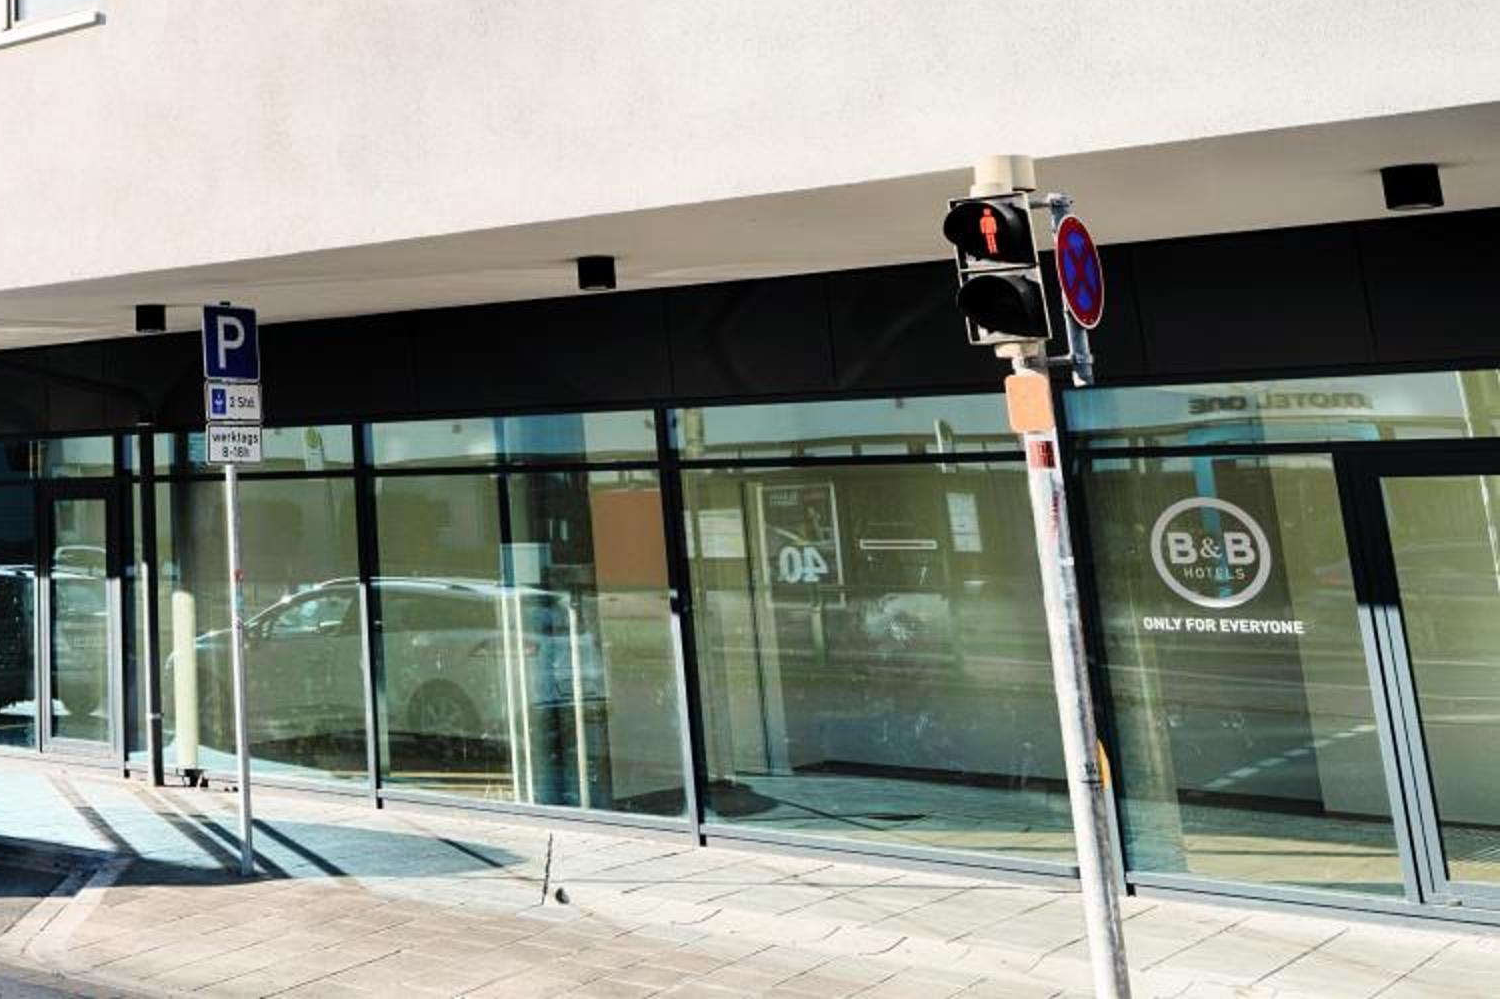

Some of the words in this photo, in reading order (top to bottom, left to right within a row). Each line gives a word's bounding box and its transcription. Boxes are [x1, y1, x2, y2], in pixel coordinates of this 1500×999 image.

[217, 315, 245, 369] P
[212, 431, 259, 446] werktags
[1167, 531, 1256, 565] B&B
[1183, 567, 1246, 580] HOTELS
[1143, 616, 1182, 631] ONLY
[1185, 617, 1217, 632] FOR
[1219, 618, 1306, 634] EVERYONE
